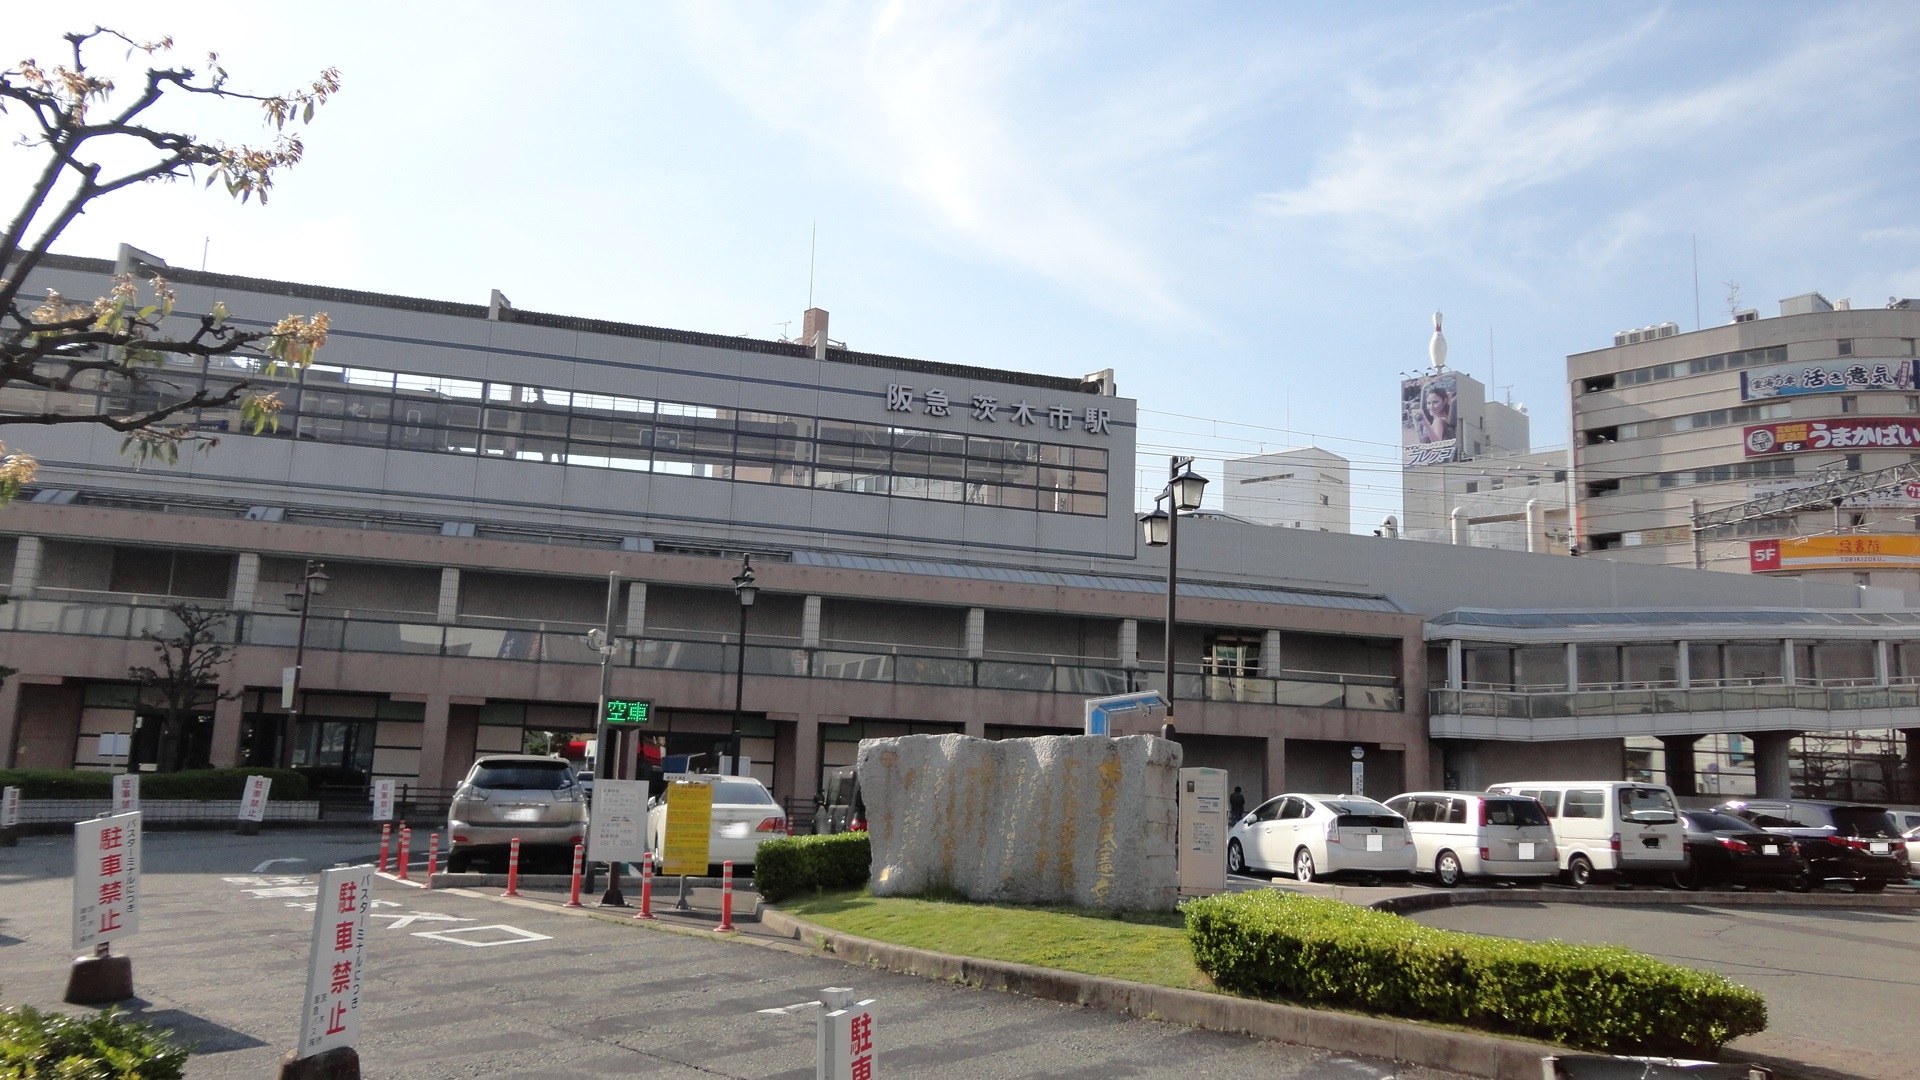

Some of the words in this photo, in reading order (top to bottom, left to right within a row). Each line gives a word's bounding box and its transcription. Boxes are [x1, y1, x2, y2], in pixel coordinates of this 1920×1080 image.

[1803, 364, 1894, 389] 活き意気
[1809, 423, 1920, 448] うまかばい
[1755, 548, 1775, 561] 5F
[607, 701, 649, 722] 空車
[98, 826, 122, 933] 駐車禁止
[125, 818, 136, 914] バスターミナルにつき
[326, 881, 357, 1036] 駐車禁止
[352, 874, 370, 1009] バスターミナルにつき
